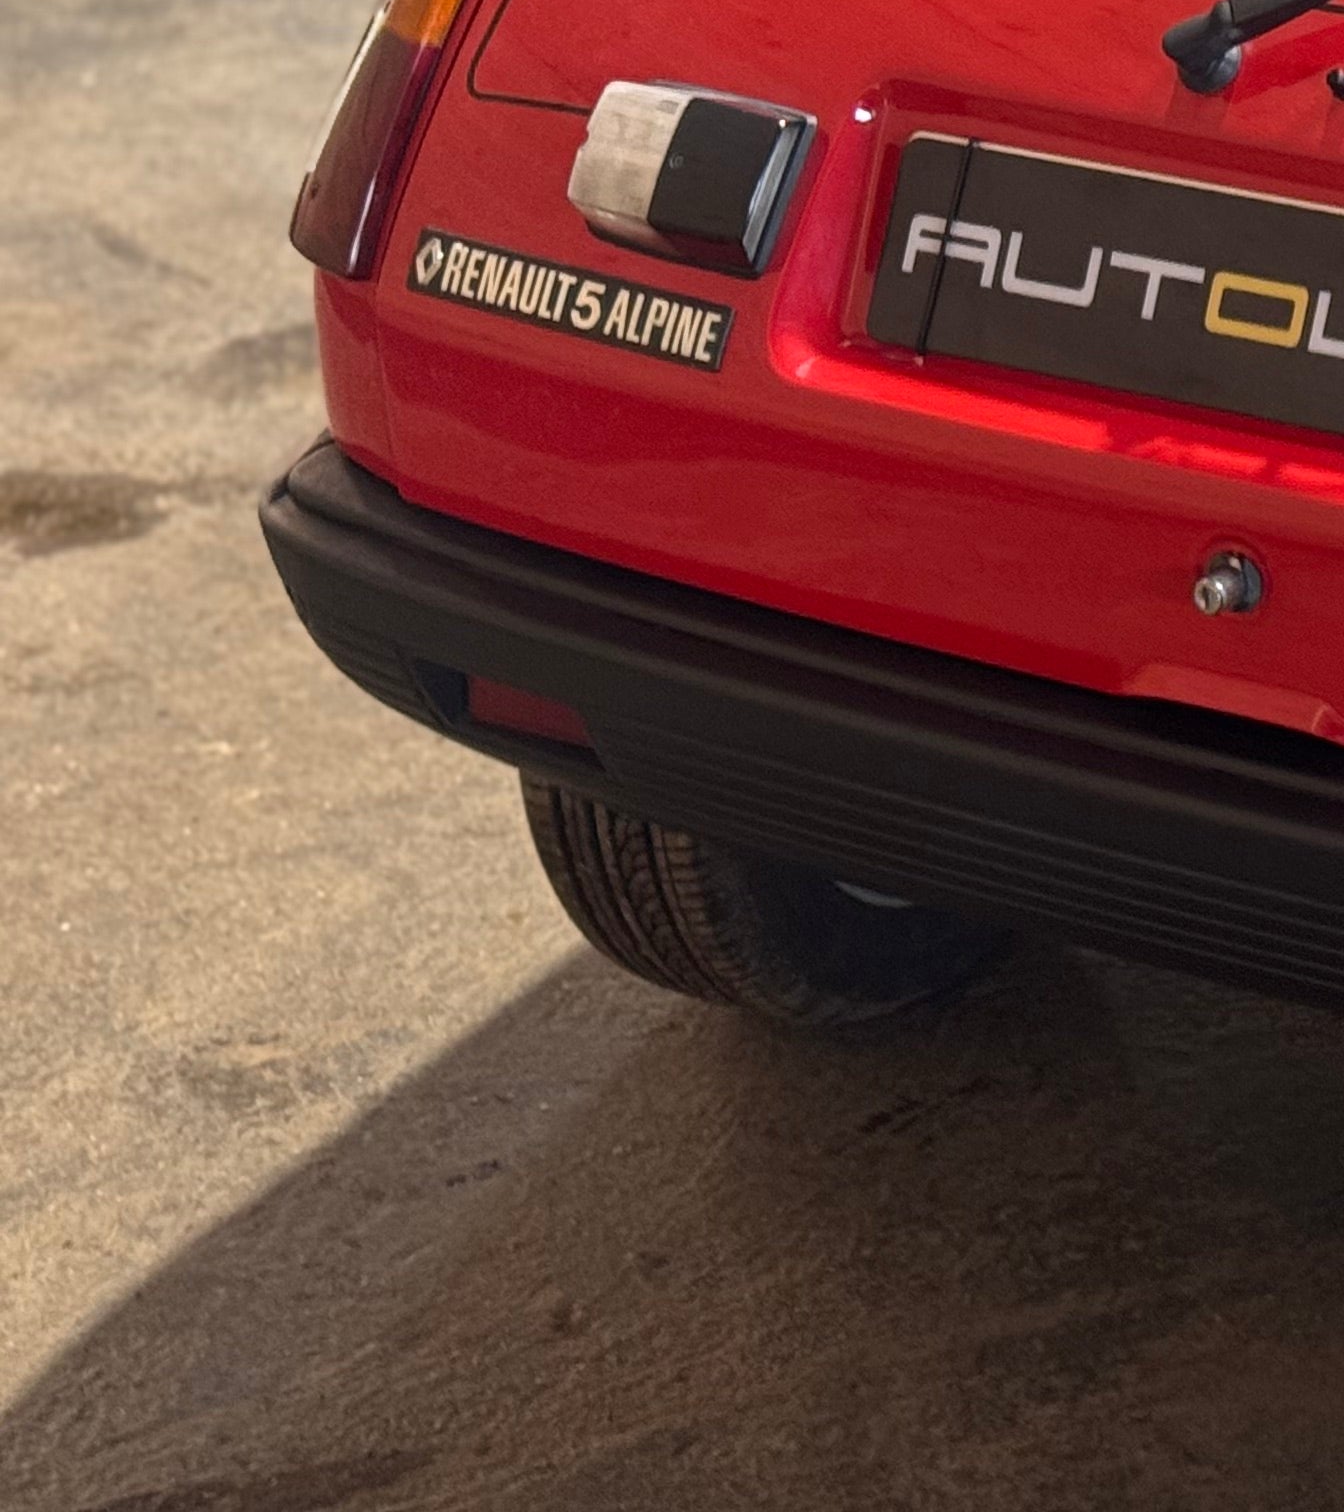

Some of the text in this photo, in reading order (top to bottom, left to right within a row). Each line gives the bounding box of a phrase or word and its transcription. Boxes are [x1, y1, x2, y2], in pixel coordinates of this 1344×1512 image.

[440, 241, 722, 363] RENAULT 5 ALPINE
